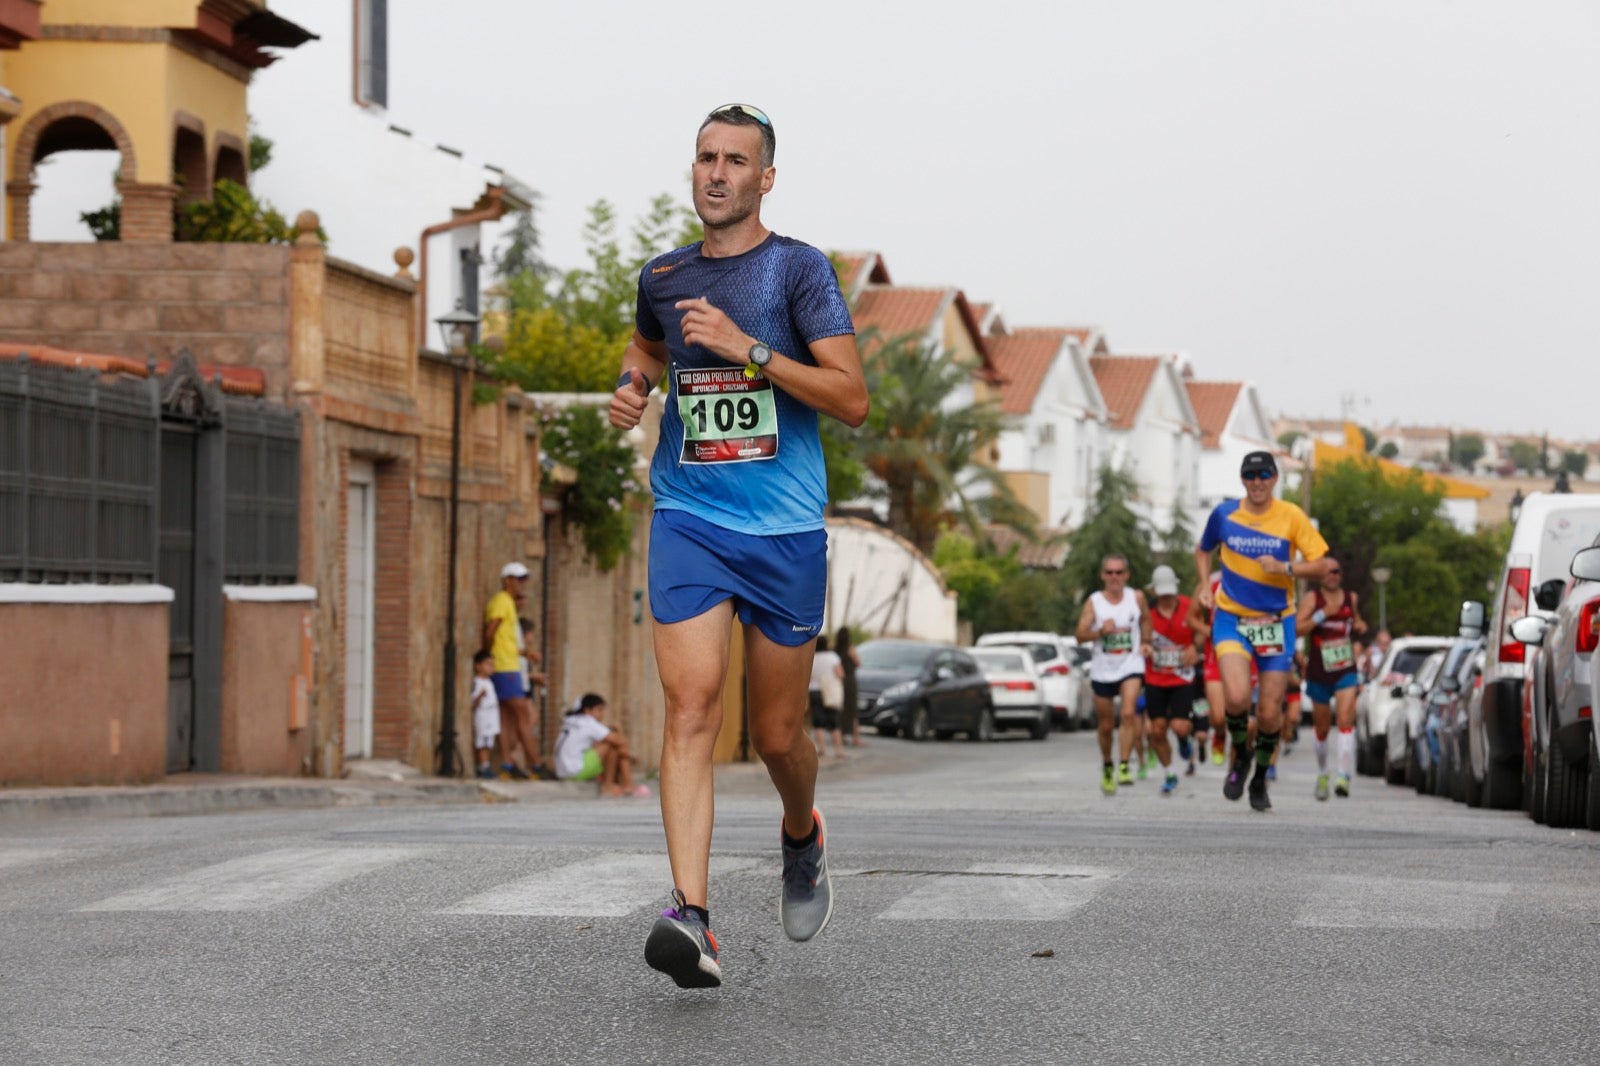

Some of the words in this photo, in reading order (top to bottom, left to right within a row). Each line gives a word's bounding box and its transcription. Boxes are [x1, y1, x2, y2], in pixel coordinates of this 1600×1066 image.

[692, 372, 711, 384] GRAN
[711, 371, 734, 383] PREMIO
[734, 371, 742, 382] DE
[691, 397, 760, 433] 109
[1246, 626, 1276, 643] 813
